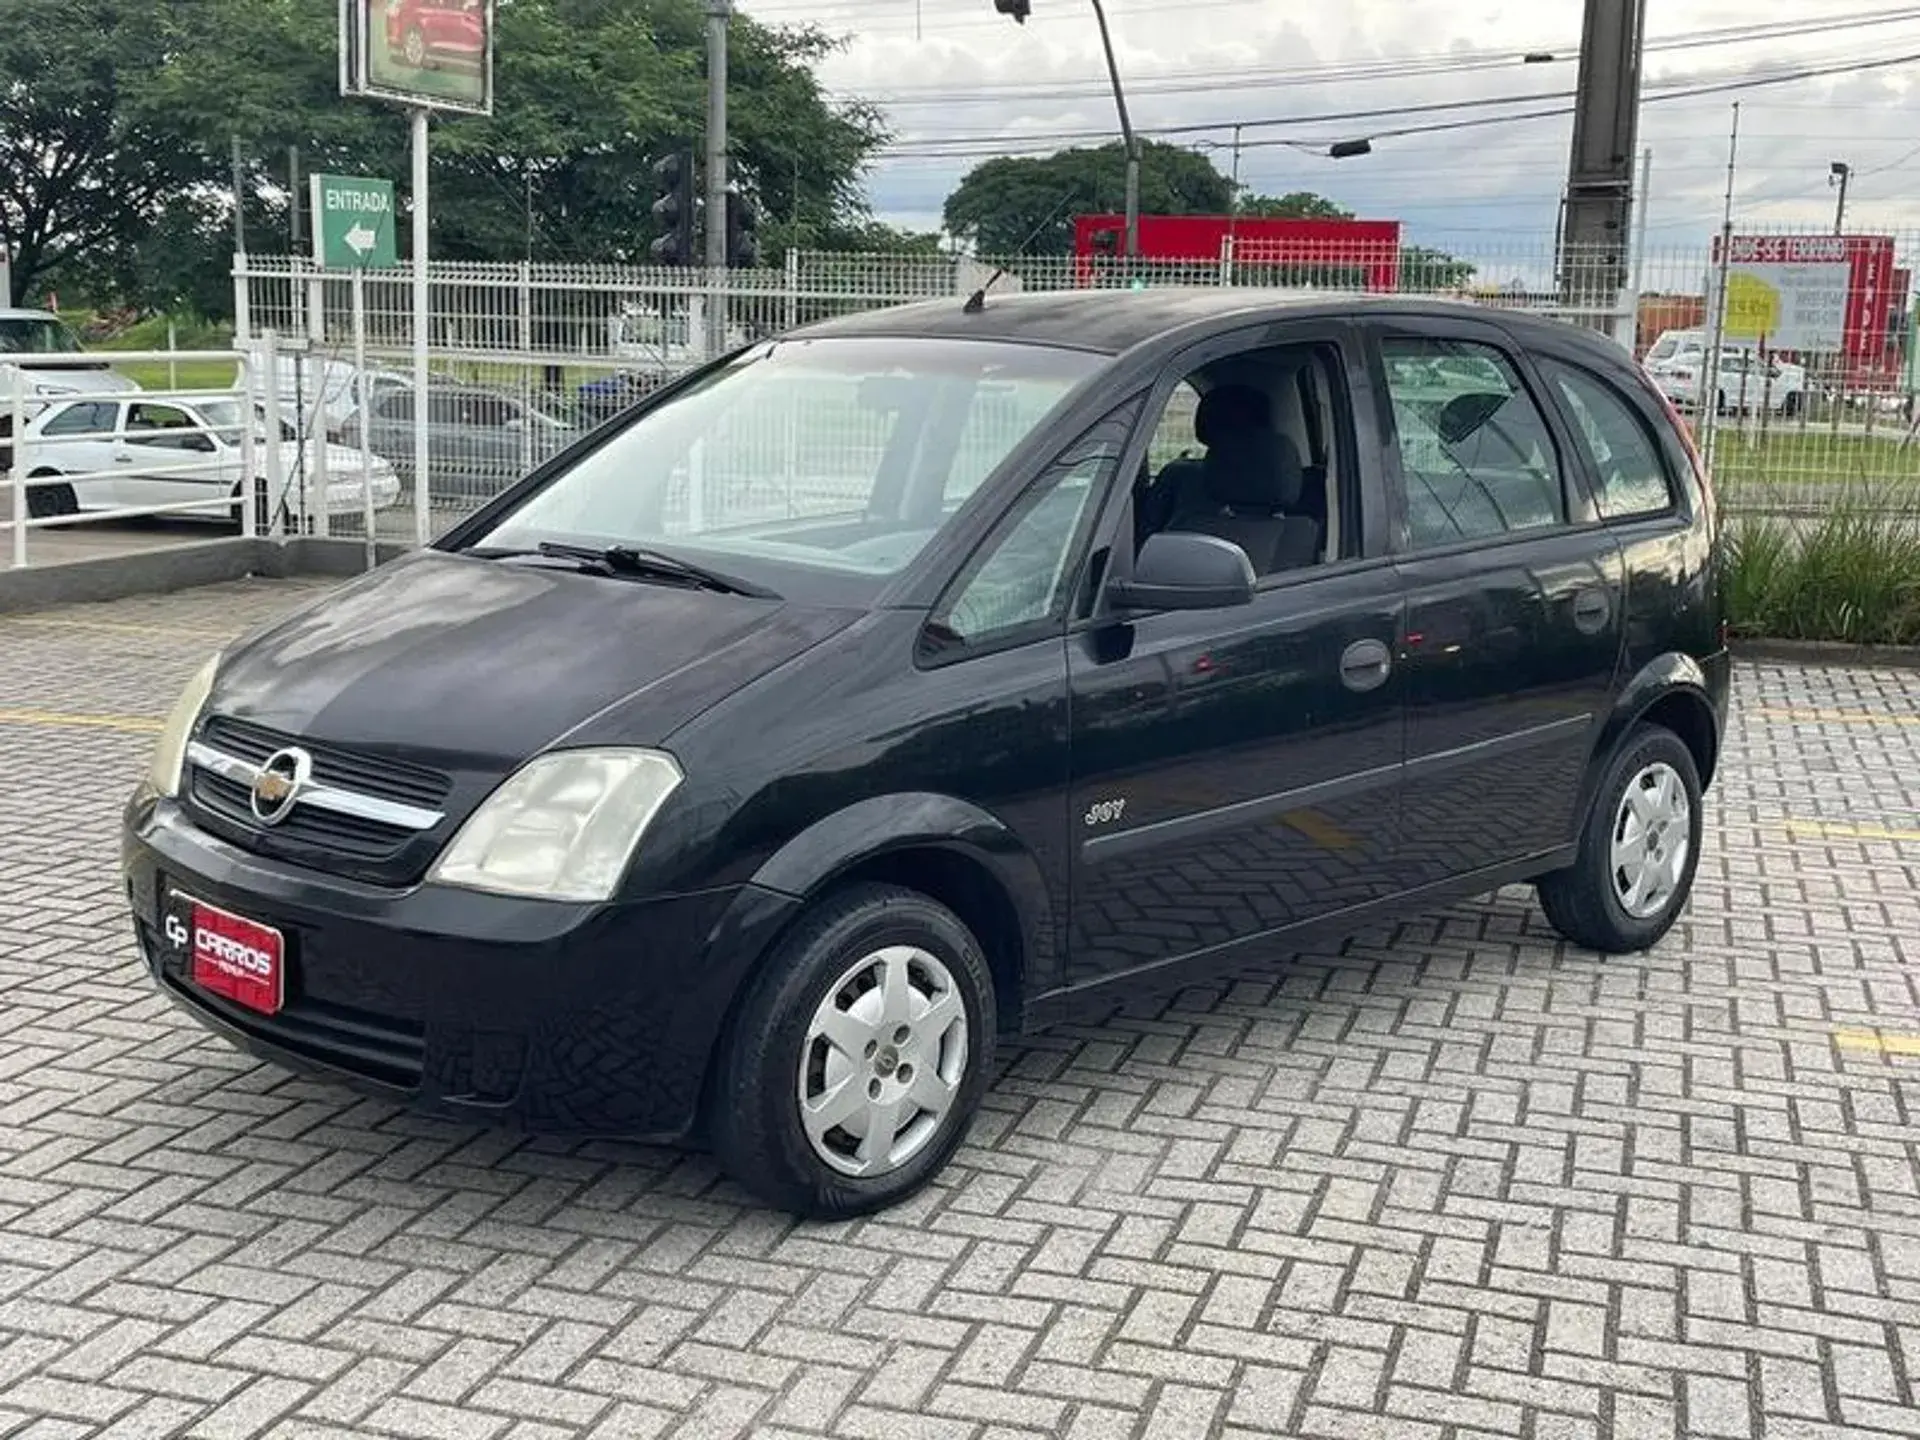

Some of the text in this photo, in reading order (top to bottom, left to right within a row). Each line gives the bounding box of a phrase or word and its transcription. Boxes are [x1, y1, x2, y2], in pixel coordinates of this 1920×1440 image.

[326, 189, 390, 212] ENTRADA
[1085, 798, 1125, 825] JOY
[195, 928, 271, 976] CARROS
